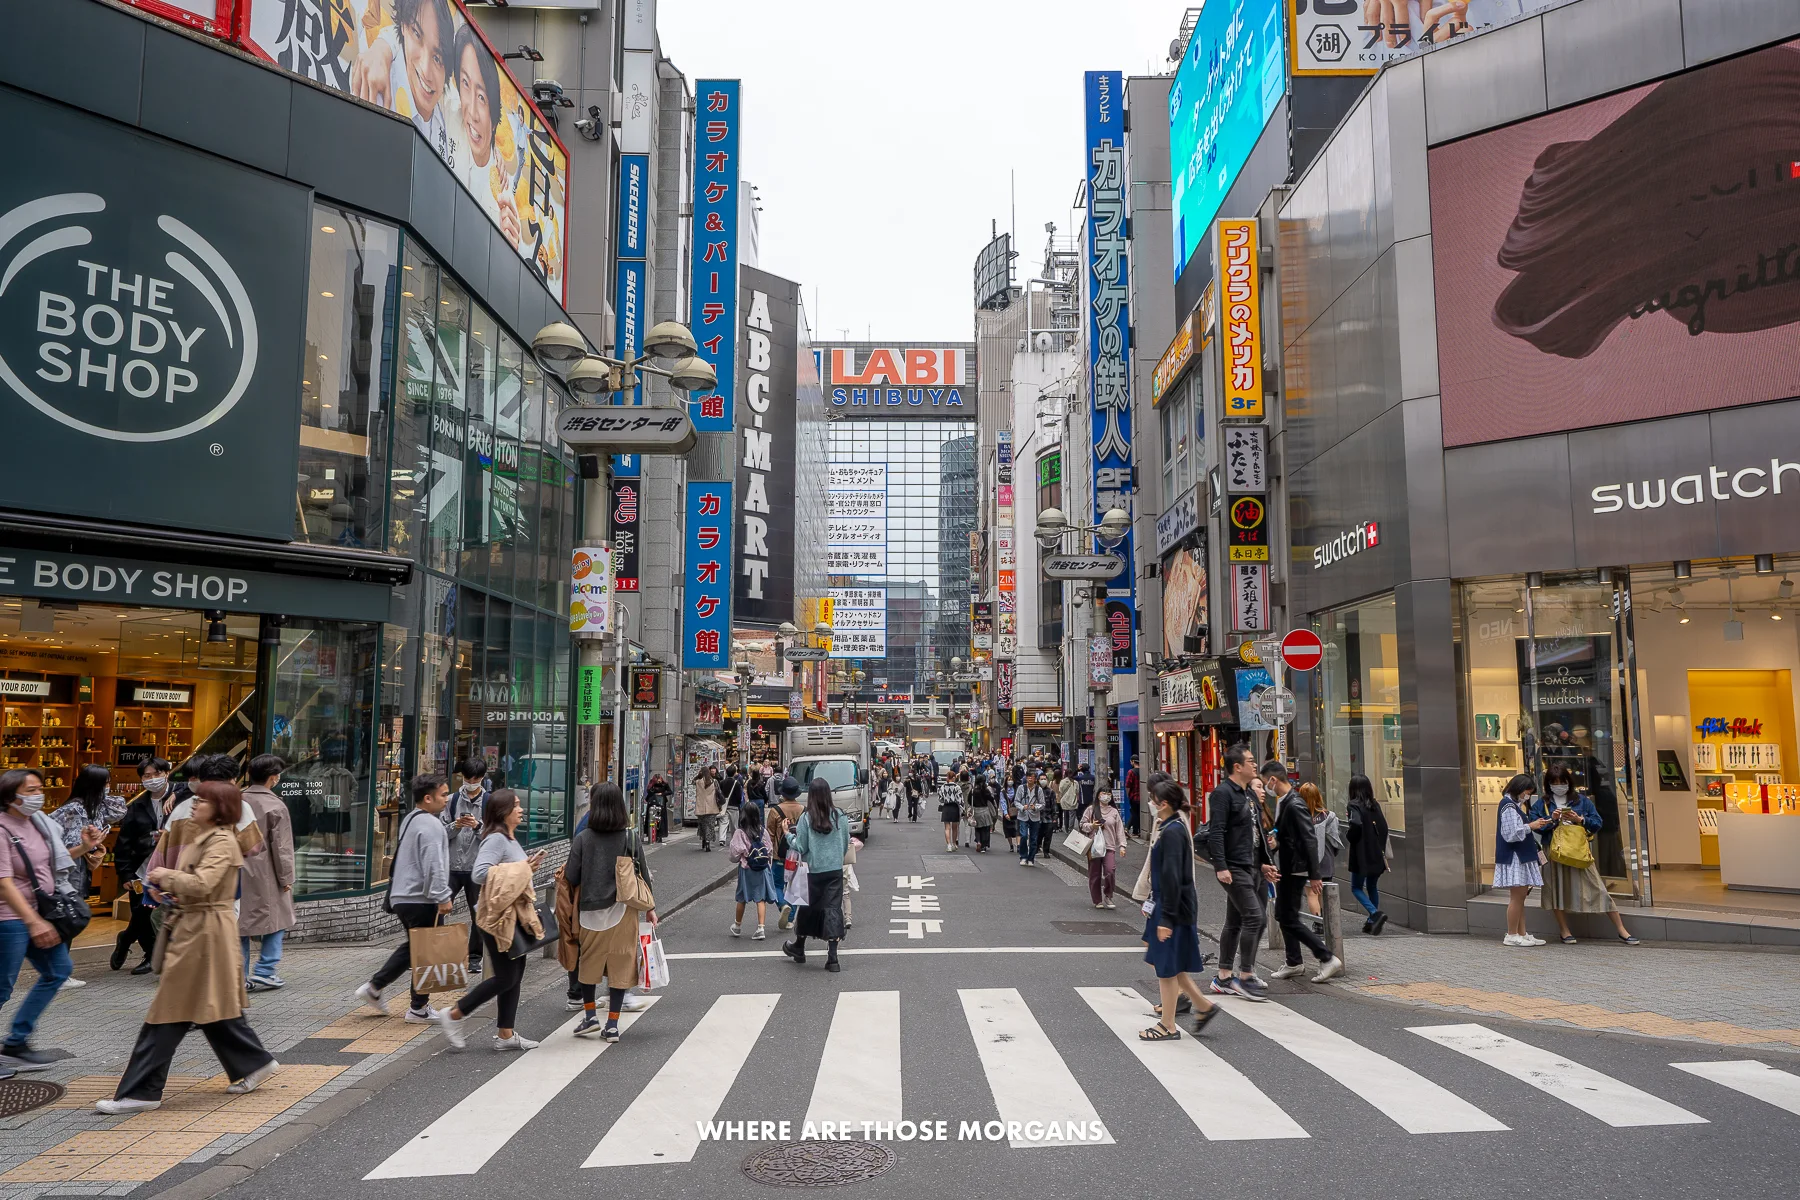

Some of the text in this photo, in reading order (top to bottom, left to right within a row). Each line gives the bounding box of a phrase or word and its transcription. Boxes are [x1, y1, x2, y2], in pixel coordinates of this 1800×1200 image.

[1098, 75, 1110, 123] キラクビル
[628, 163, 640, 249] SKECHERS
[77, 259, 175, 315] THE
[1092, 139, 1131, 462] カラオケの鉄人
[625, 269, 637, 350] SKECHER
[1225, 226, 1254, 391] プリクラのメッカ
[36, 290, 206, 363] BODY
[35, 341, 199, 405] SHOP
[831, 348, 965, 386] LABI
[407, 383, 453, 401] SINCE 1976
[832, 388, 963, 406] SHIBUYA
[1231, 397, 1257, 410] 3F
[433, 415, 463, 442] BORN IN
[563, 416, 683, 432] 渋谷センター街
[467, 425, 518, 467] BRIGHTON
[1228, 431, 1249, 485] ふたご
[829, 477, 875, 485] ミューズメント
[1096, 467, 1131, 488] 2F
[1591, 458, 1800, 514] swatch
[614, 486, 637, 524] HUB
[1235, 502, 1260, 523] 油
[615, 530, 625, 572] HOUSE
[624, 530, 634, 554] ALE
[1233, 547, 1264, 558] 春日亭
[1238, 530, 1258, 541] そば
[1313, 524, 1368, 569] swatch
[34, 560, 143, 594] BODY
[572, 558, 590, 575] Enjoy
[695, 493, 721, 654] カラオケ館
[1048, 561, 1118, 570] 渋谷センター街
[1242, 576, 1258, 629] 元祖寿司
[1, 682, 38, 693] YOUR BODY
[142, 691, 182, 701] LOVE YOUR BODY
[583, 669, 593, 721] 客引きは犯罪です
[1544, 677, 1585, 685] OMEGA
[1539, 696, 1585, 705] swatch
[121, 752, 137, 760] TRY
